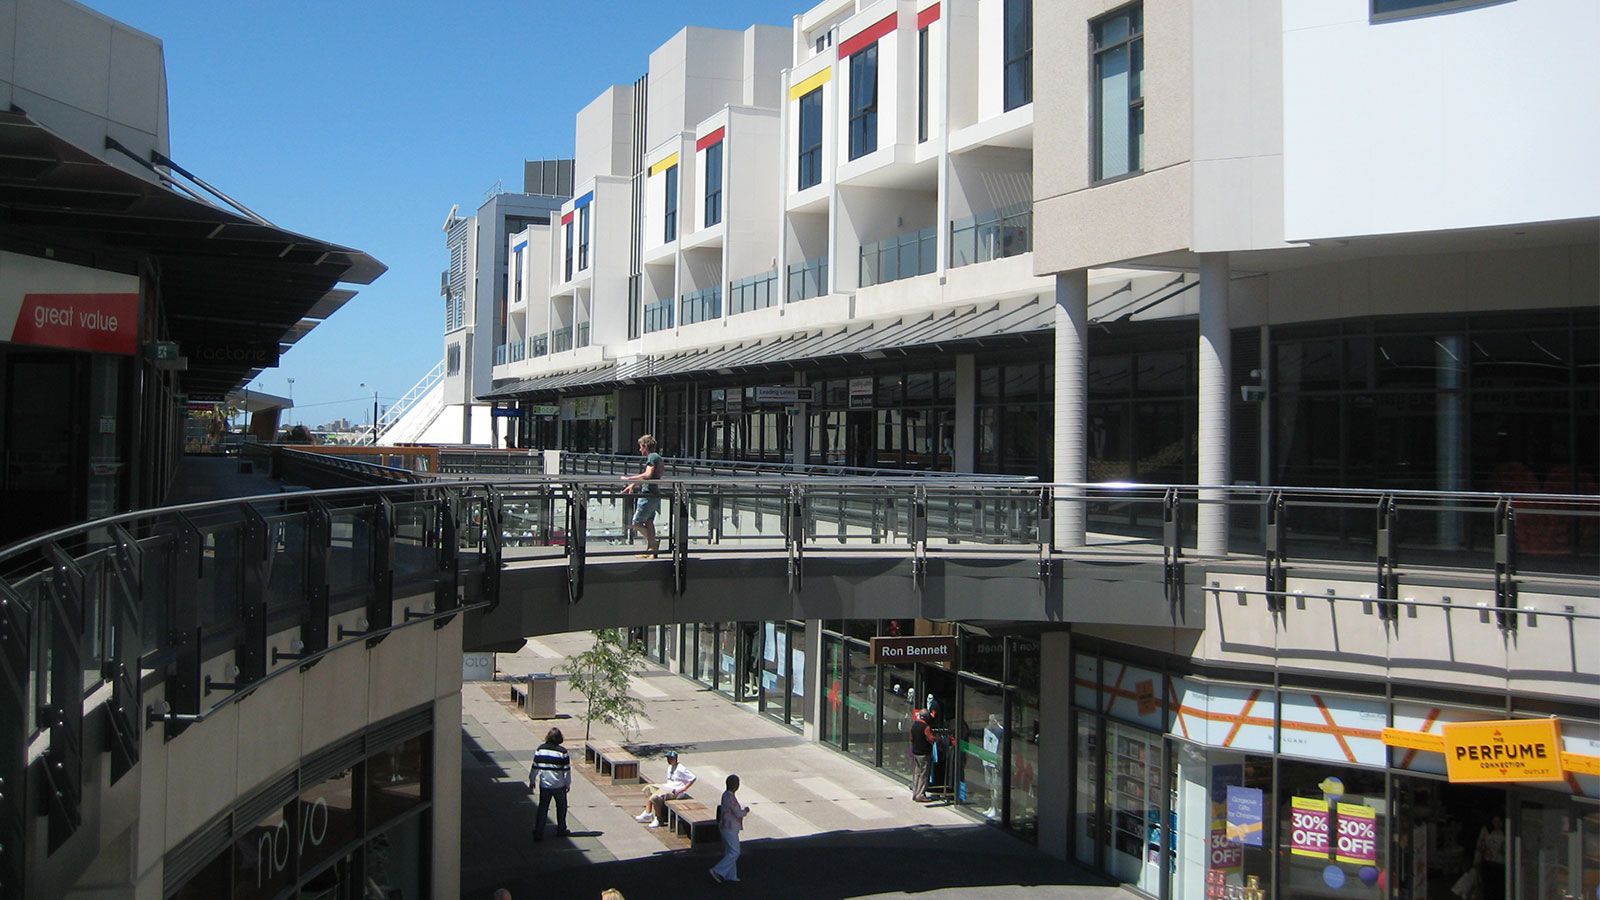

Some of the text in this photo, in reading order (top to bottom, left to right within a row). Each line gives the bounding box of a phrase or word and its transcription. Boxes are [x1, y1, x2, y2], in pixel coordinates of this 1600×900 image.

[34, 305, 118, 332] great value
[194, 343, 266, 361] factorie
[882, 644, 948, 656] Ron Bennett
[1456, 743, 1547, 761] PERFUME
[1480, 761, 1526, 769] CONNECTION
[1292, 813, 1329, 831] 30%
[1337, 819, 1375, 838] 30%
[1292, 829, 1328, 847] OFF
[1337, 836, 1375, 854] OFF
[1211, 849, 1241, 864] OFF
